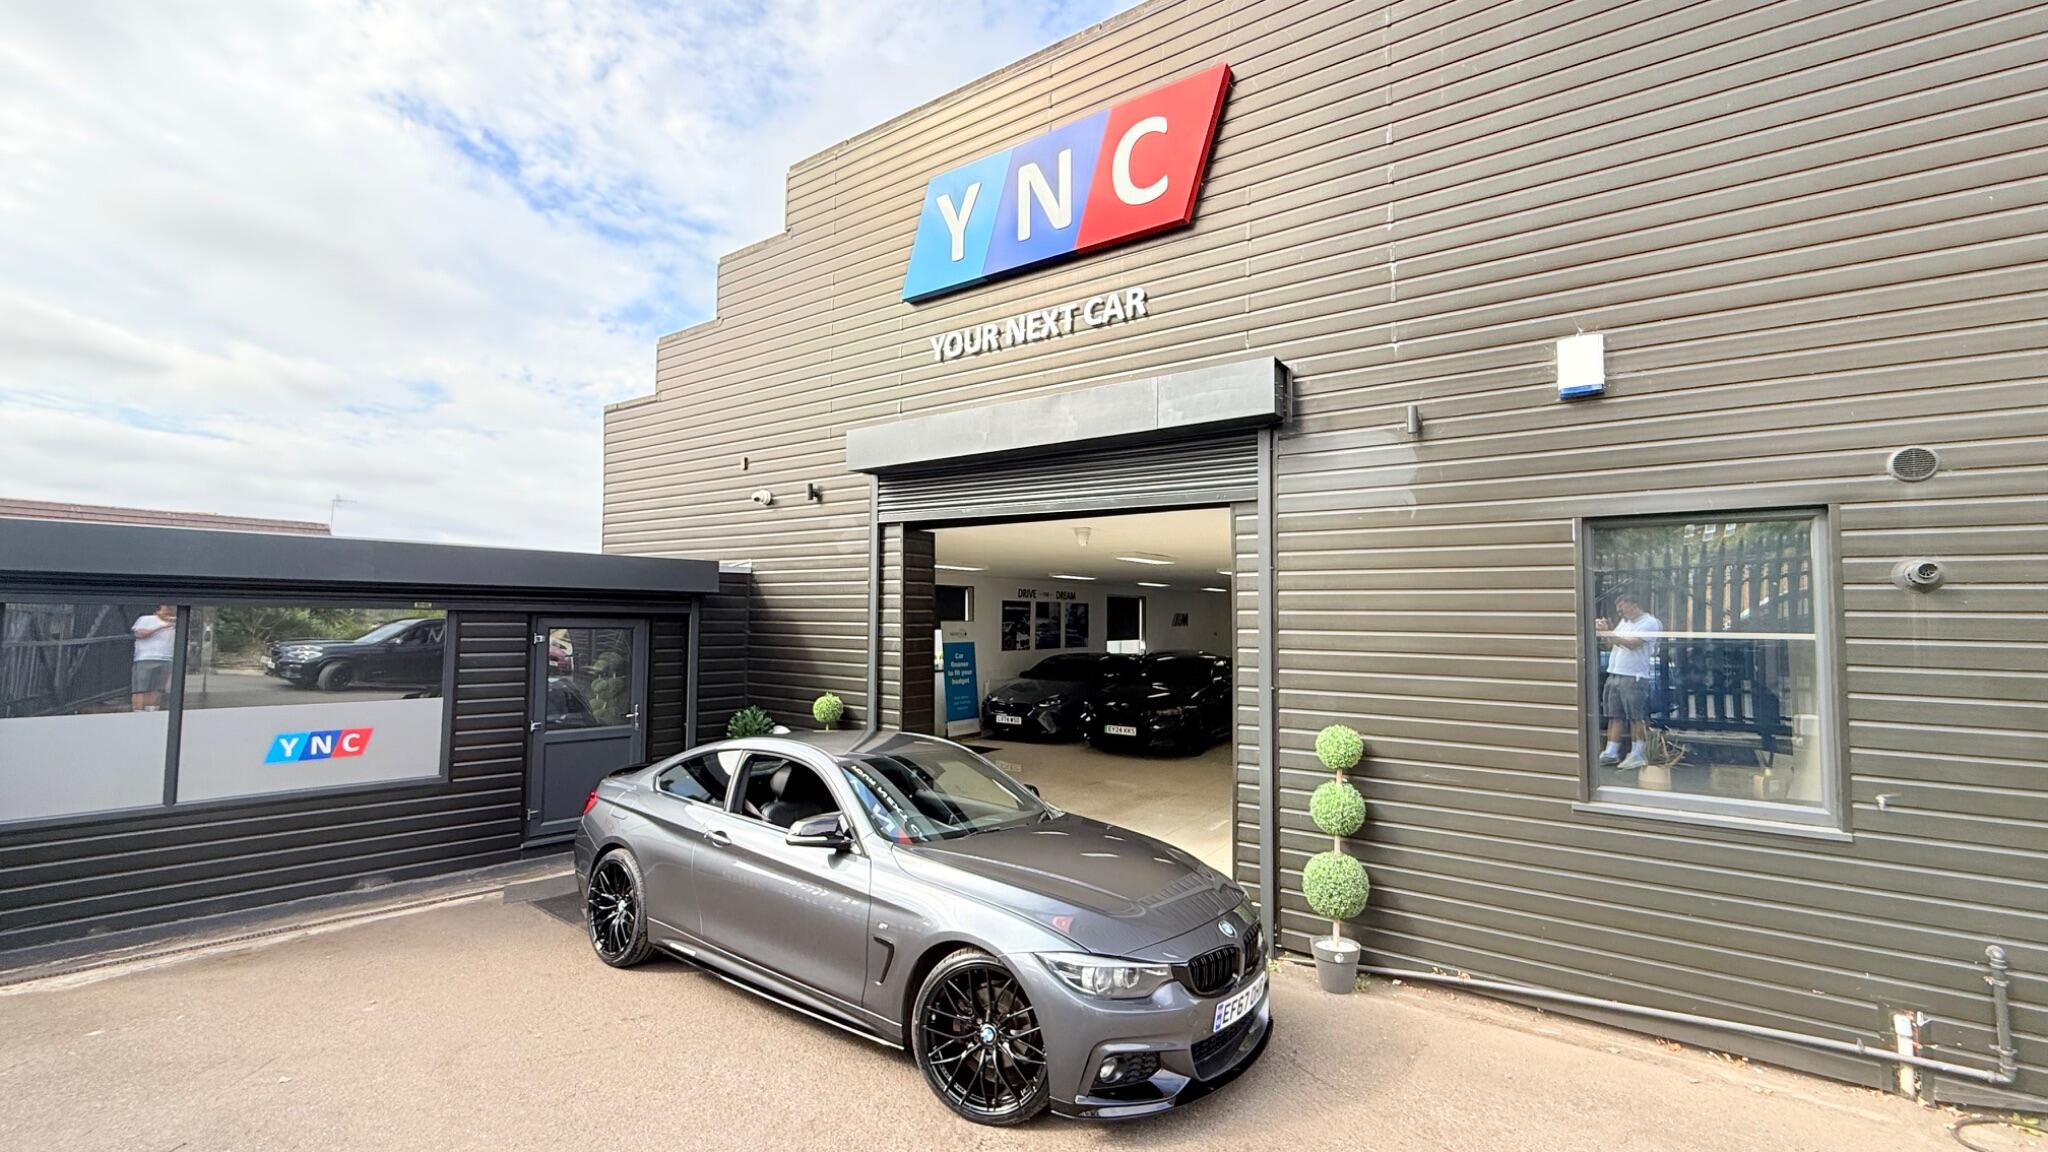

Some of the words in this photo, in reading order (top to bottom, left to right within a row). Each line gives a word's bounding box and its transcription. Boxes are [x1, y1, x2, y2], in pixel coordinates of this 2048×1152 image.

[936, 115, 1169, 262] YNC
[930, 324, 999, 362] YOUR
[1005, 303, 1077, 346] NEXT
[1083, 287, 1147, 326] CAR
[1018, 589, 1037, 599] DRIVE
[1056, 591, 1076, 600] DREAM
[279, 733, 361, 758] YNC
[1222, 991, 1250, 1024] EF67
